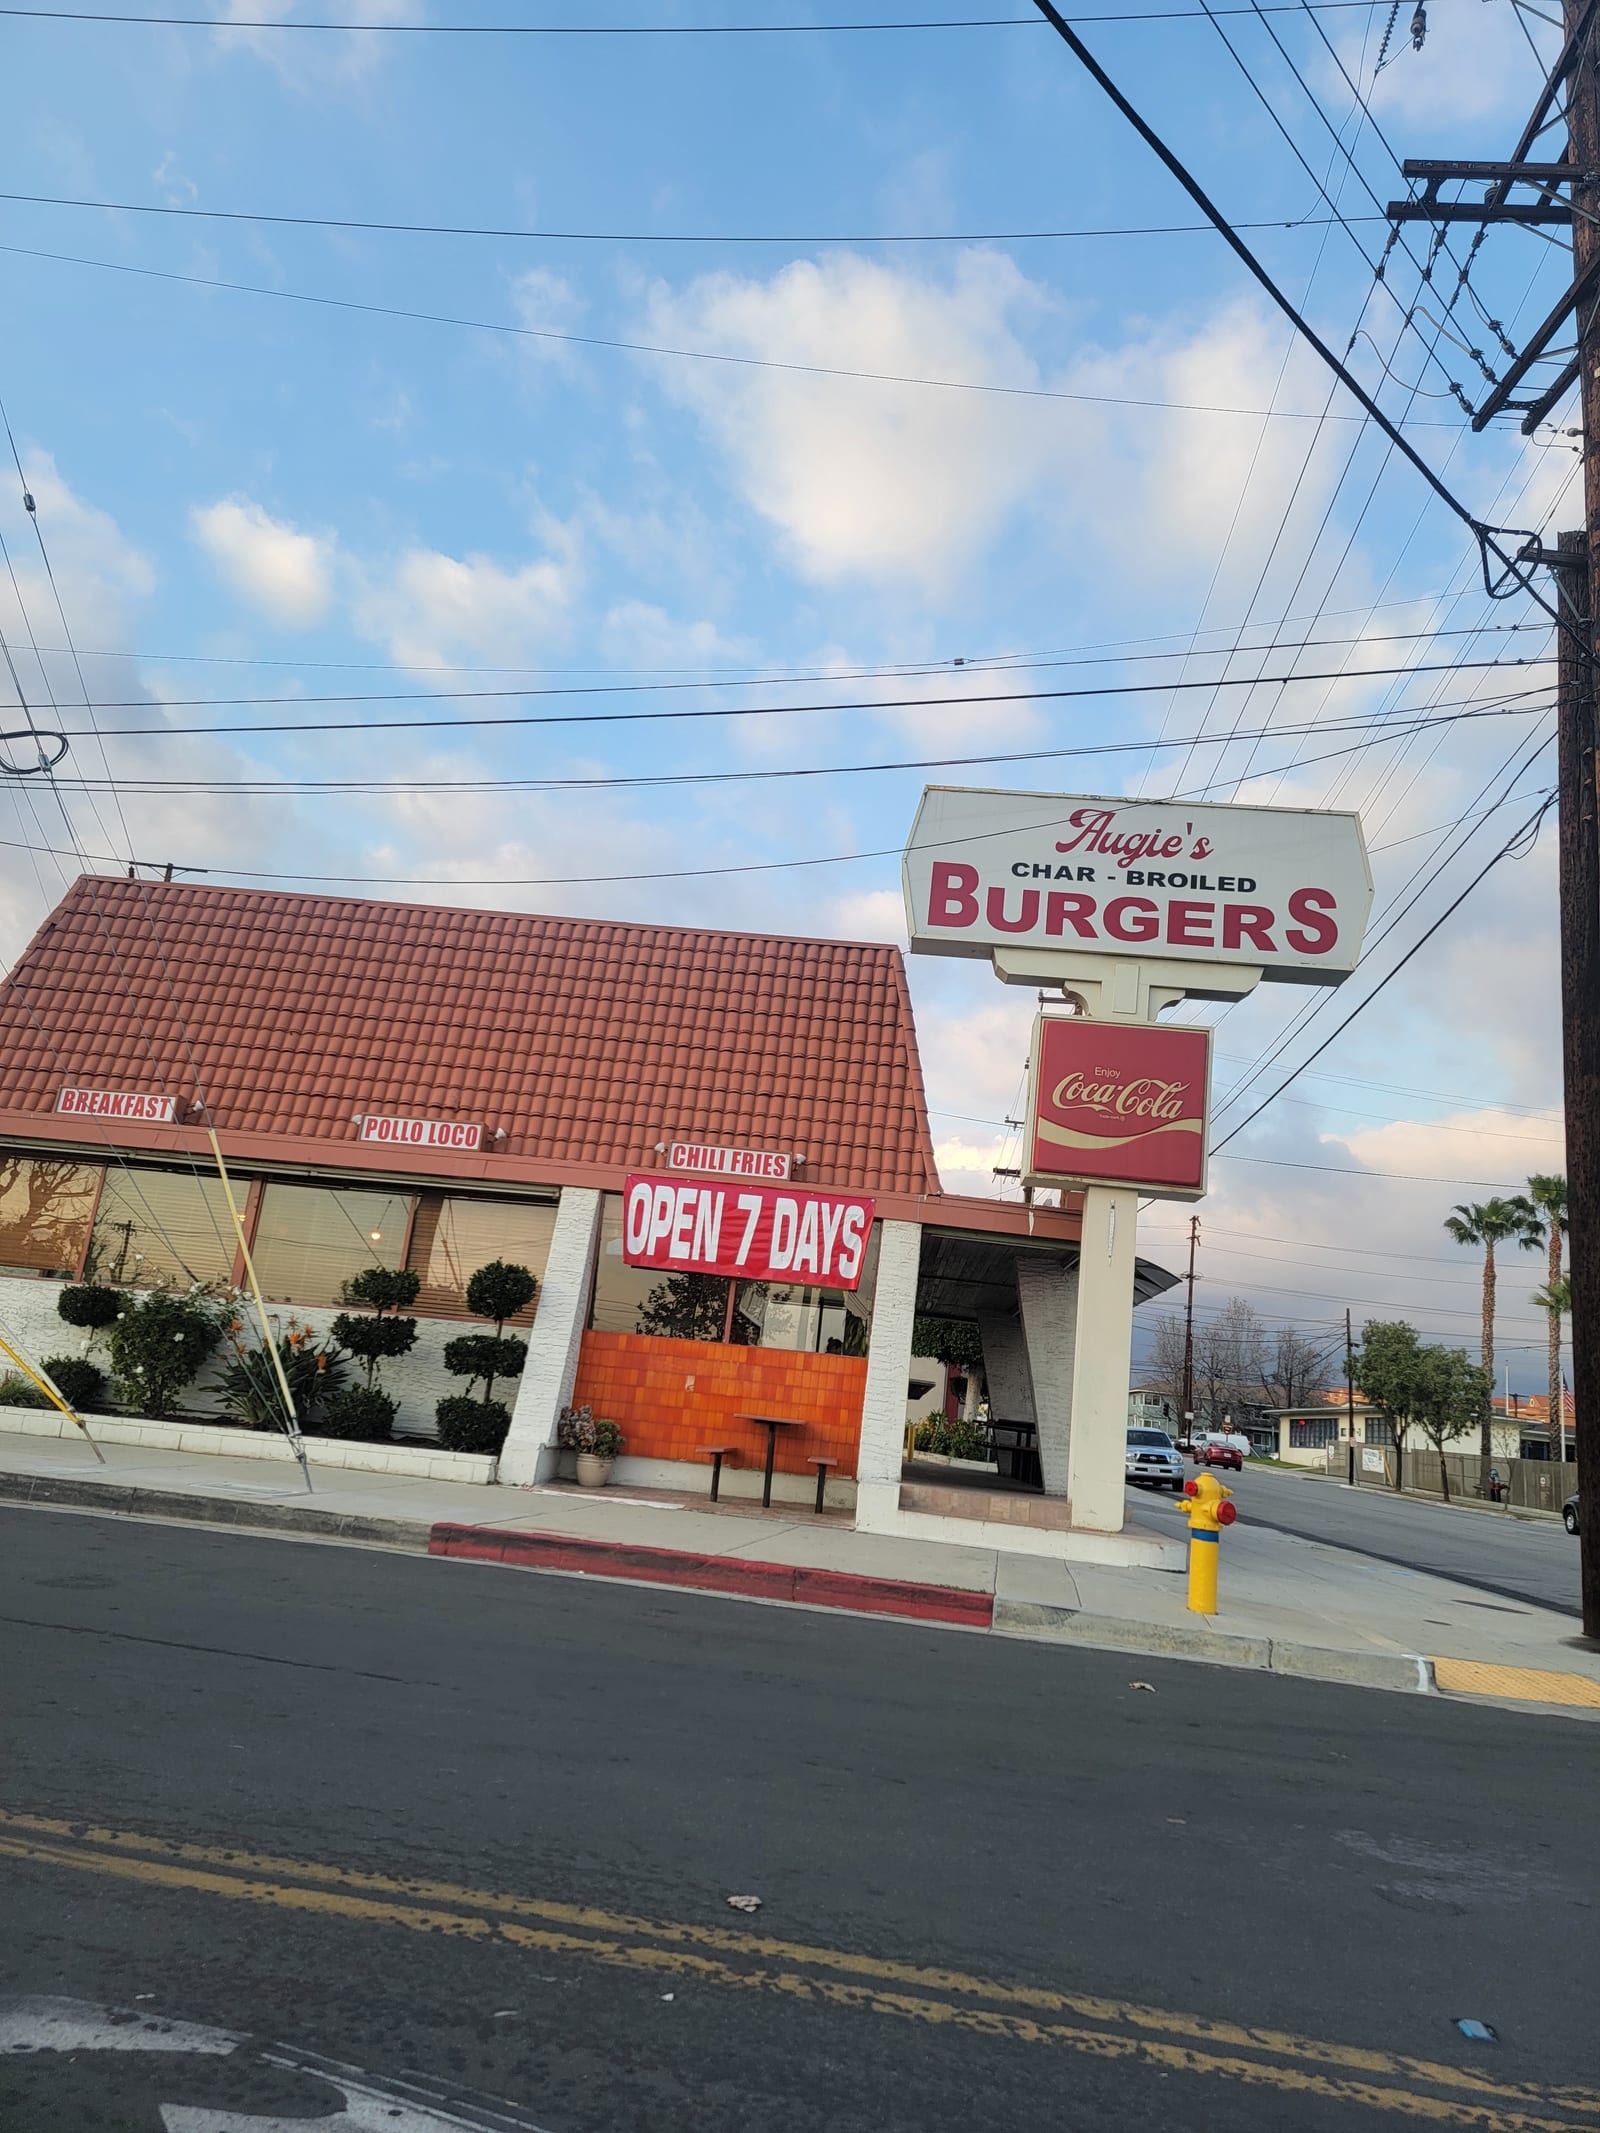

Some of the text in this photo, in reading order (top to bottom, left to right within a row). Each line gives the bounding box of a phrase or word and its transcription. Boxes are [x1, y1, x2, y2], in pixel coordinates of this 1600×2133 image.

[1055, 808, 1215, 869] Augie's
[1011, 862, 1096, 883] CHAR
[1126, 870, 1257, 893] BROILED
[927, 861, 1339, 955] BURGERS
[1095, 1066, 1120, 1078] Enjoy
[61, 1090, 171, 1119] BREAKFAST
[1052, 1072, 1191, 1119] Coca-Cola
[364, 1118, 479, 1148] POLLO LOCO
[672, 1144, 787, 1177] CHILI FRIES
[627, 1182, 865, 1280] OPEN 7 DAYS
